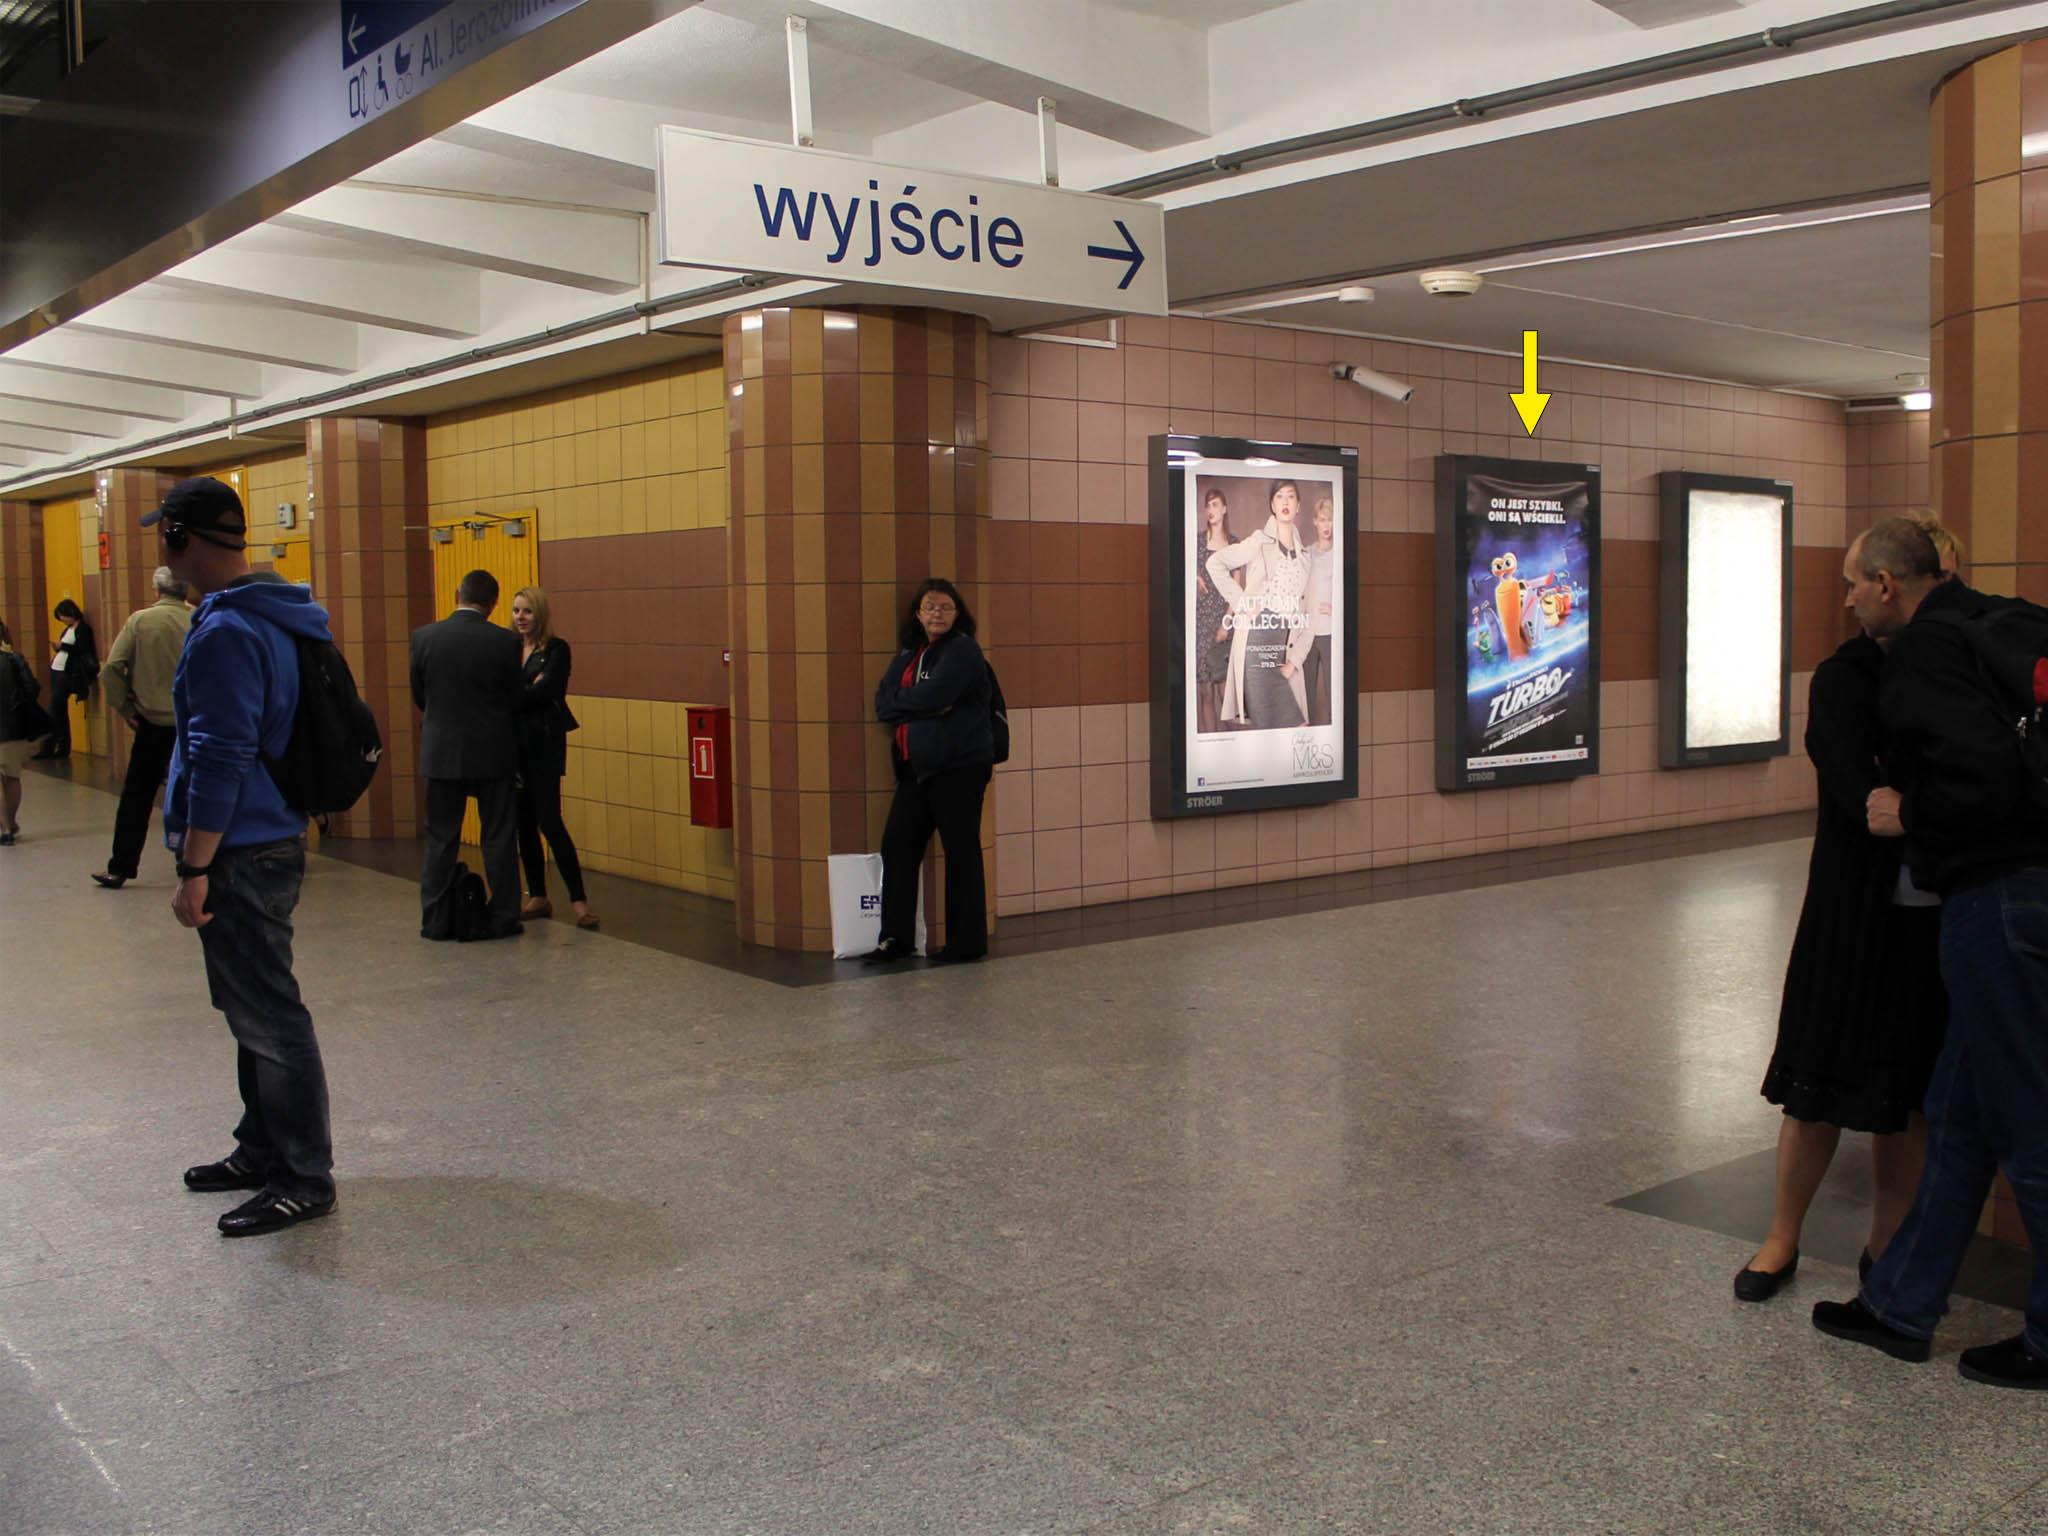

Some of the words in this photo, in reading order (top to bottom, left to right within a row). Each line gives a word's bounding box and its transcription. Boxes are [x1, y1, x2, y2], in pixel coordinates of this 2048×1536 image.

[420, 25, 444, 77] Al.
[753, 179, 1025, 268] wyjście
[1488, 511, 1507, 522] ONI
[1508, 511, 1522, 526] SĄ
[1522, 509, 1566, 524] WŚCIEKLI.
[1490, 498, 1506, 509] ON
[1507, 498, 1528, 510] JEST
[1529, 499, 1564, 512] SZYBKI.
[1222, 612, 1310, 630] COLLECTION
[1487, 667, 1574, 728] TURBO
[1292, 743, 1335, 771] M&S
